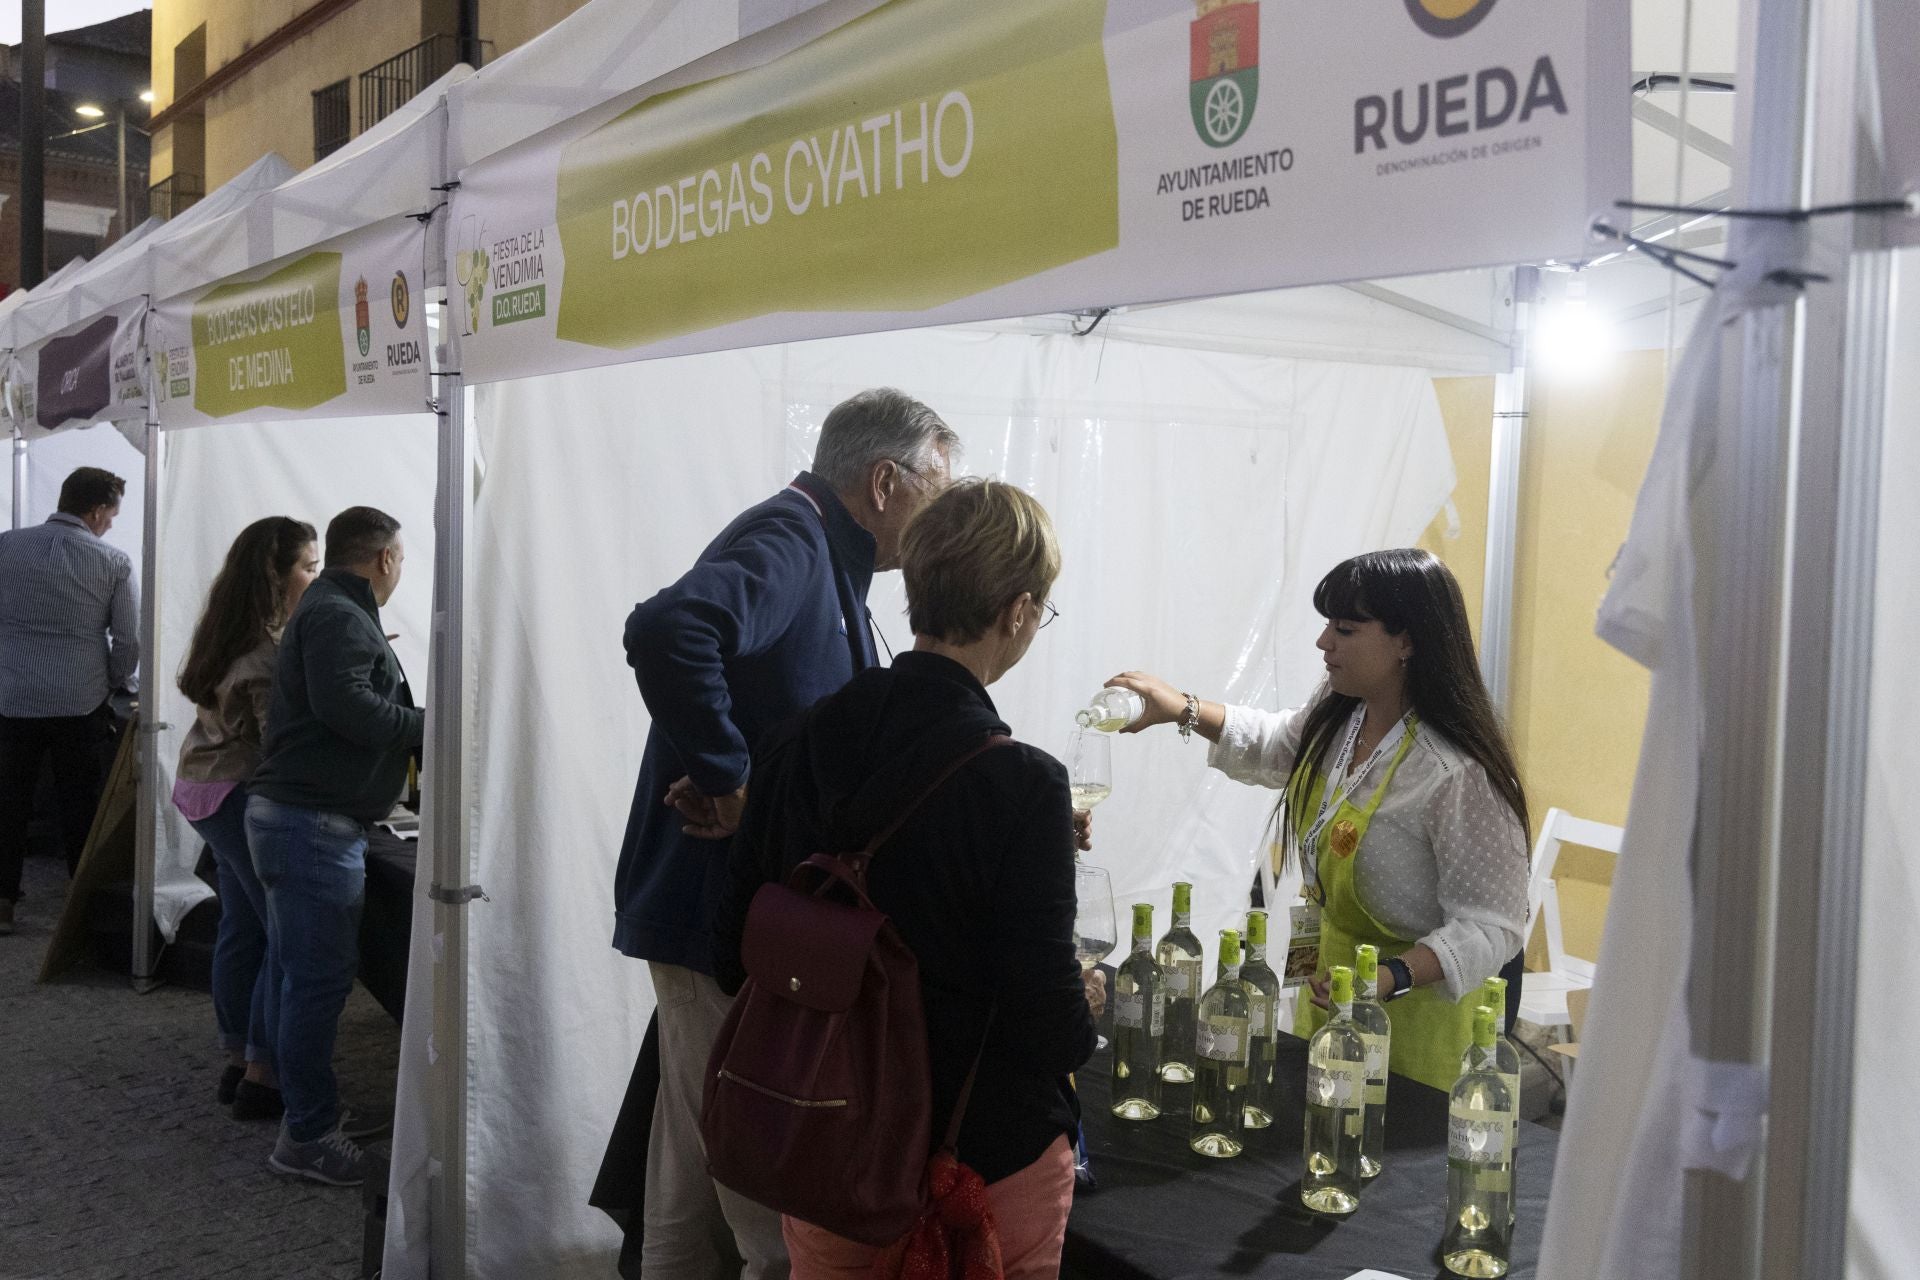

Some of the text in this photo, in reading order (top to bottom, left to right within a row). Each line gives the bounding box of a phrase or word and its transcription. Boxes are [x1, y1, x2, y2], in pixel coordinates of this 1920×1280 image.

[1353, 55, 1568, 155] RUEDA
[612, 91, 974, 261] BODEGAS CYATHO
[1156, 148, 1294, 195] AYUNTAMIENTO
[1376, 135, 1542, 176] DENOMINACIÓN DE ORIGEN
[1182, 186, 1270, 222] DE RUEDA
[493, 228, 545, 261] FIESTA DE LA
[492, 253, 544, 290] VENDIMIA
[207, 284, 315, 346] BODEGAS CASTELO
[496, 290, 541, 319] D.O. RUEDA
[229, 355, 245, 391] DE
[246, 347, 294, 389] MEDINA
[386, 340, 421, 367] RUEDA
